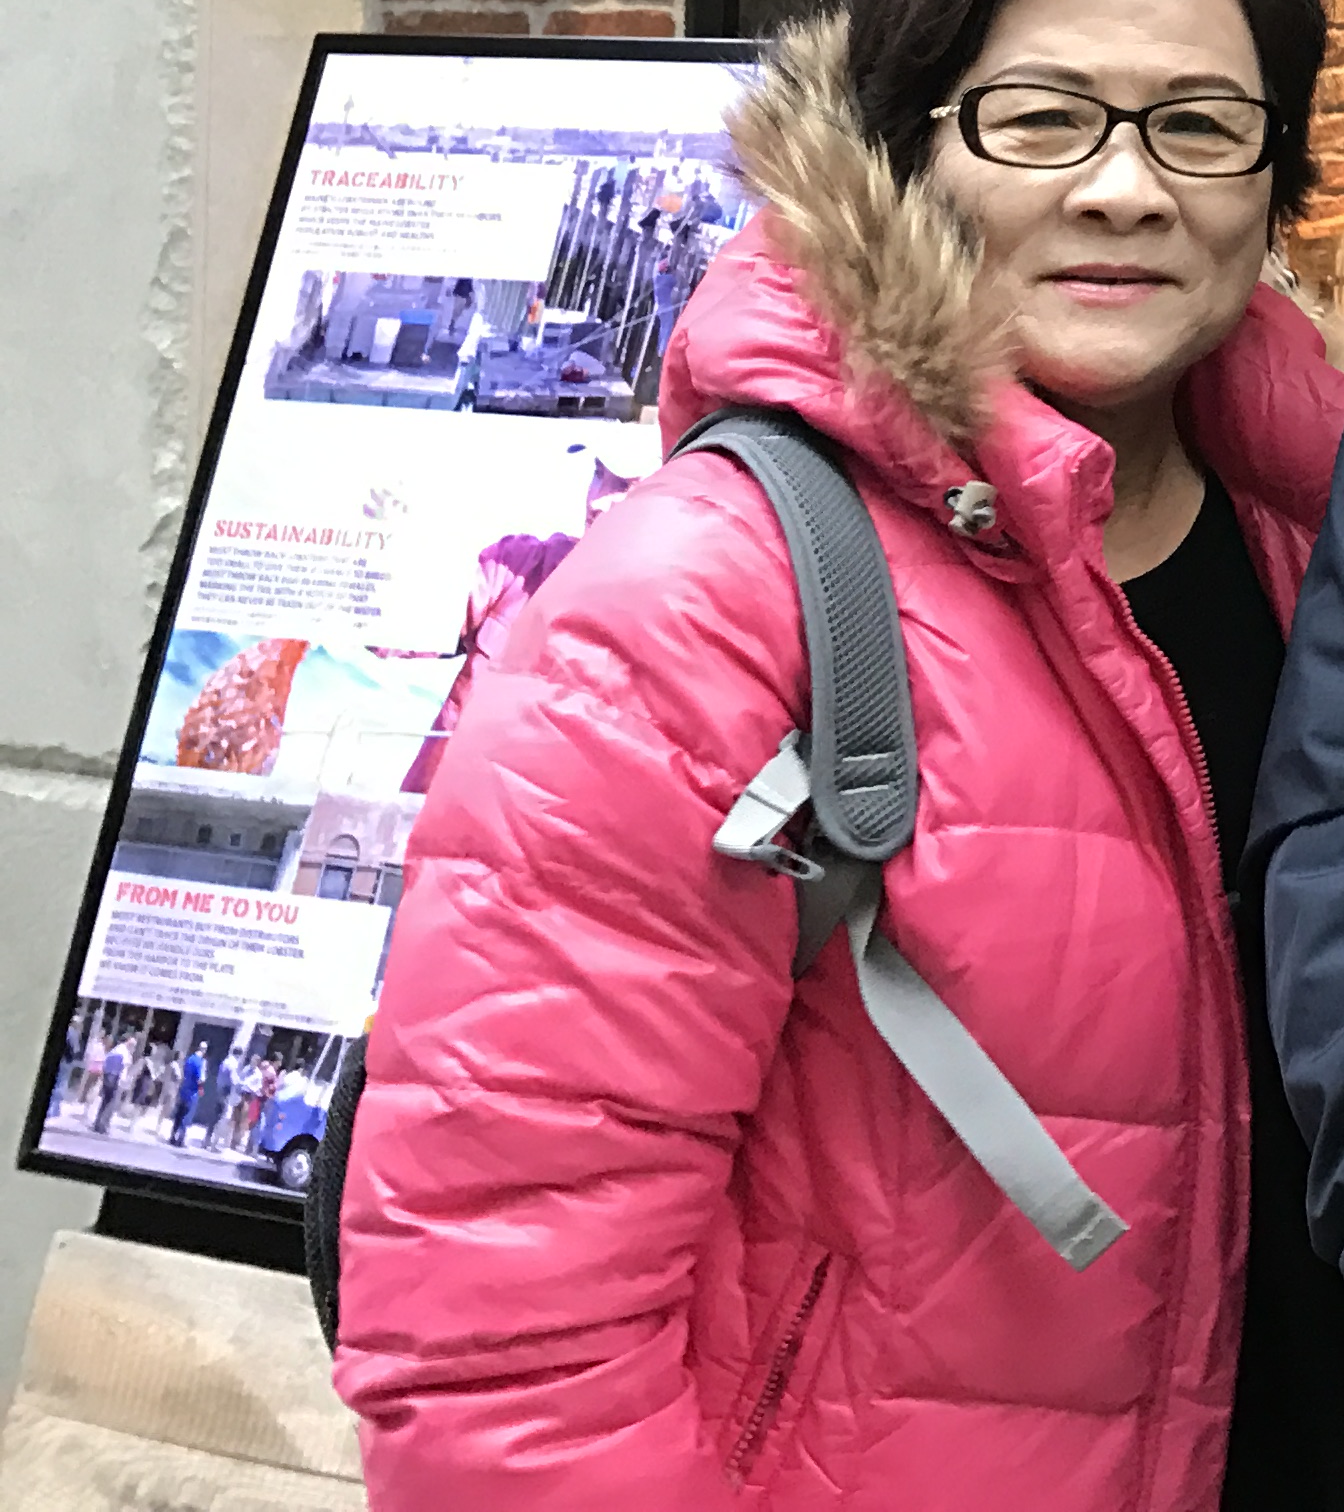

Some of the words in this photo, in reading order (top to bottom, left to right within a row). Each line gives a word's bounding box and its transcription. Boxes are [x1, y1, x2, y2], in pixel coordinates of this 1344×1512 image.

[310, 169, 464, 191] TRACEABILITY
[213, 519, 392, 550] SUSTAINABILITY
[116, 881, 179, 910] FROM
[182, 890, 215, 914] ME
[221, 895, 249, 918] TO
[255, 900, 299, 925] YOU
